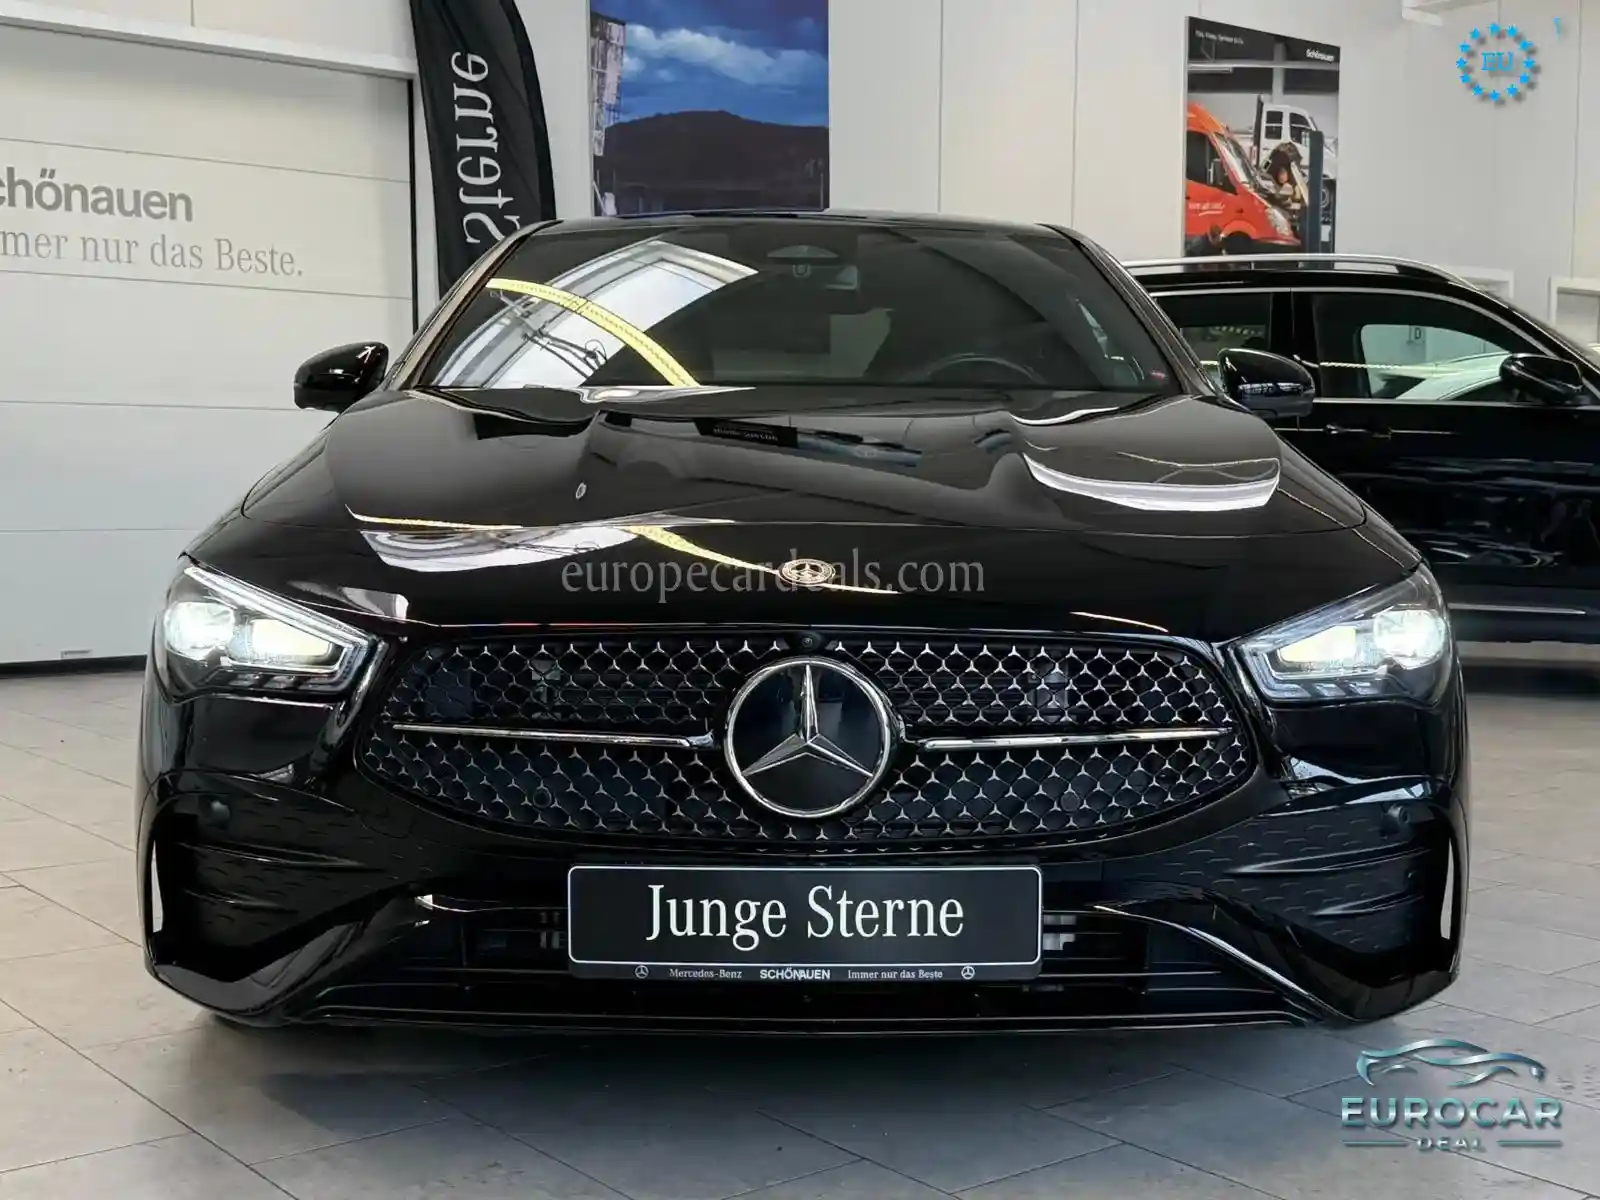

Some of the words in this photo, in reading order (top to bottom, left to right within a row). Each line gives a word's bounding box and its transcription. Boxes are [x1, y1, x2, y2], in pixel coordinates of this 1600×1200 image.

[0, 166, 193, 222] hönauen
[80, 235, 139, 265] nur
[150, 233, 203, 269] das
[214, 237, 304, 277] Beste.
[646, 884, 787, 952] Junge
[808, 885, 965, 938] Sterne
[669, 968, 743, 979] Mercedes-Benz
[759, 967, 831, 980] SCHÖNAUEN
[847, 969, 879, 979] Immer
[881, 971, 898, 979] nur
[899, 968, 916, 979] das
[918, 969, 943, 979] Beste
